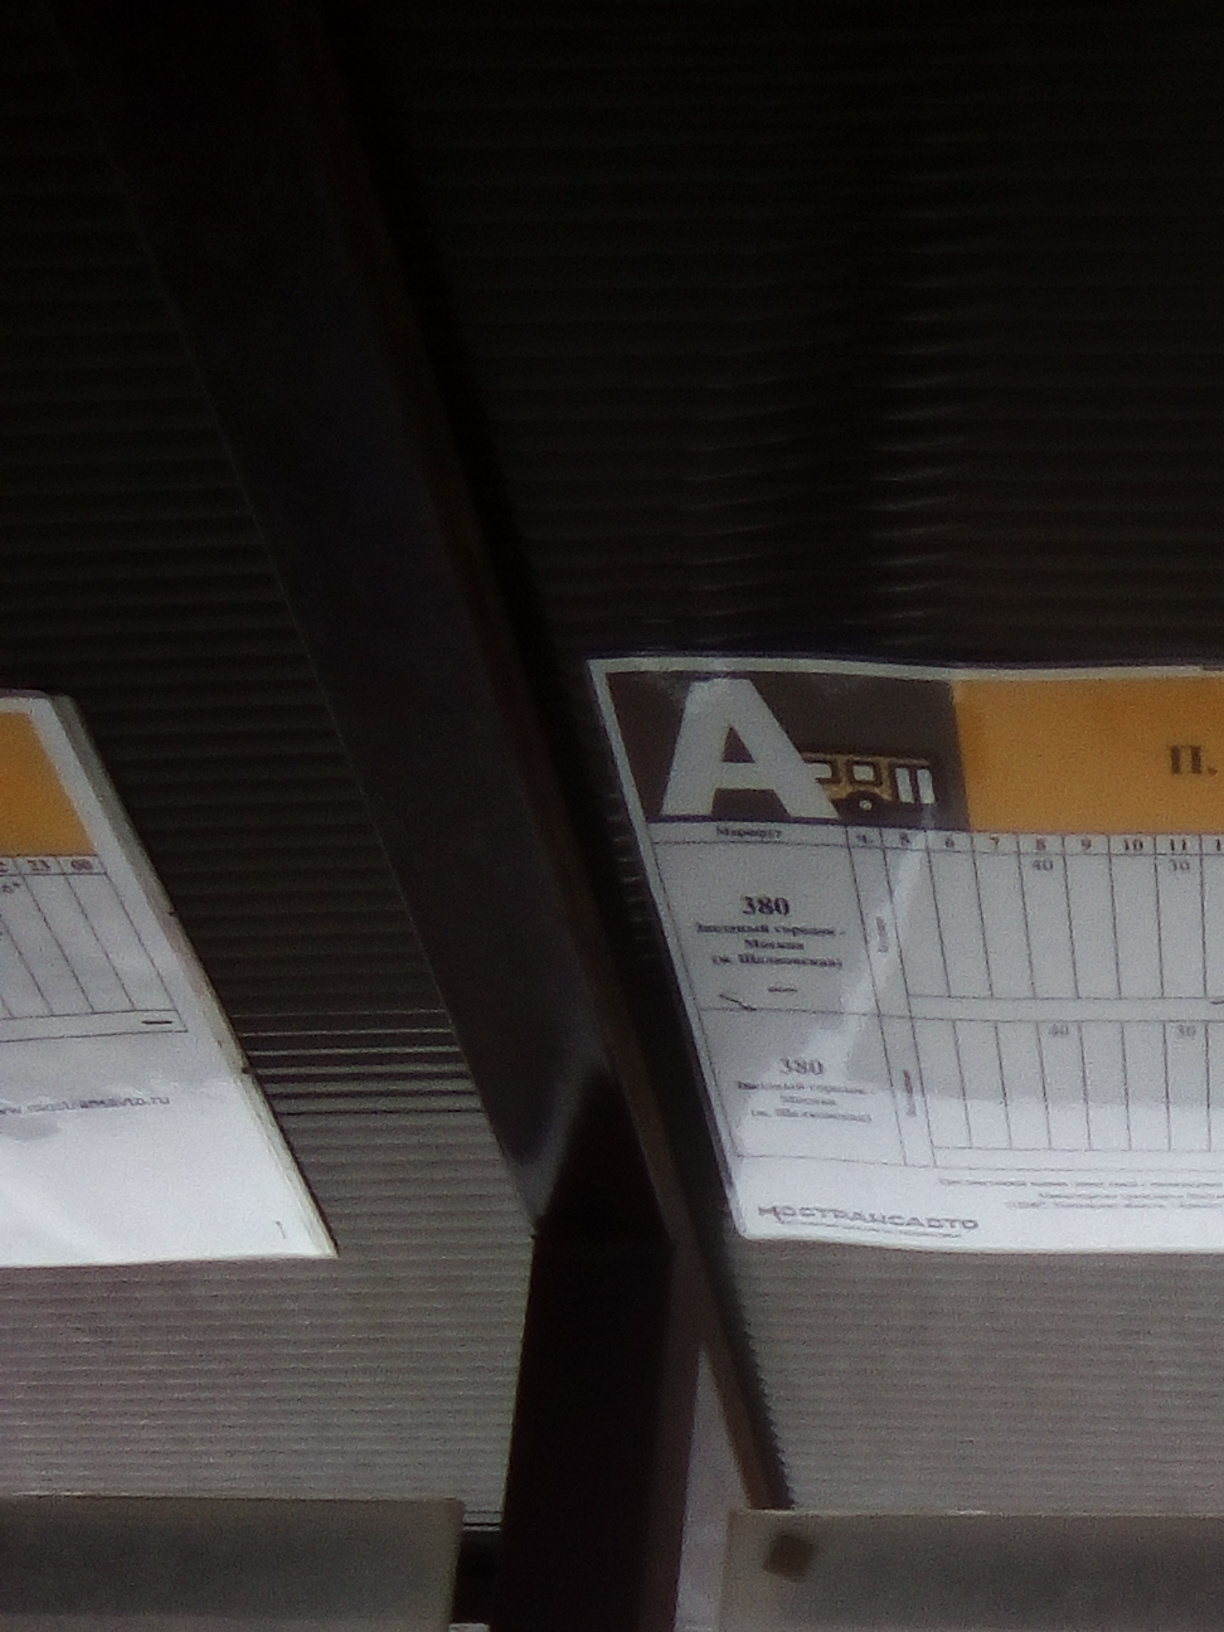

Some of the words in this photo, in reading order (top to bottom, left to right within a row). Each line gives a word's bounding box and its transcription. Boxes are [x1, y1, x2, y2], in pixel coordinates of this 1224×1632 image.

[1034, 835, 1046, 850] 8
[1080, 836, 1091, 850] 9
[1124, 837, 1144, 851] 10
[1169, 837, 1187, 851] 11
[743, 896, 790, 916] 380
